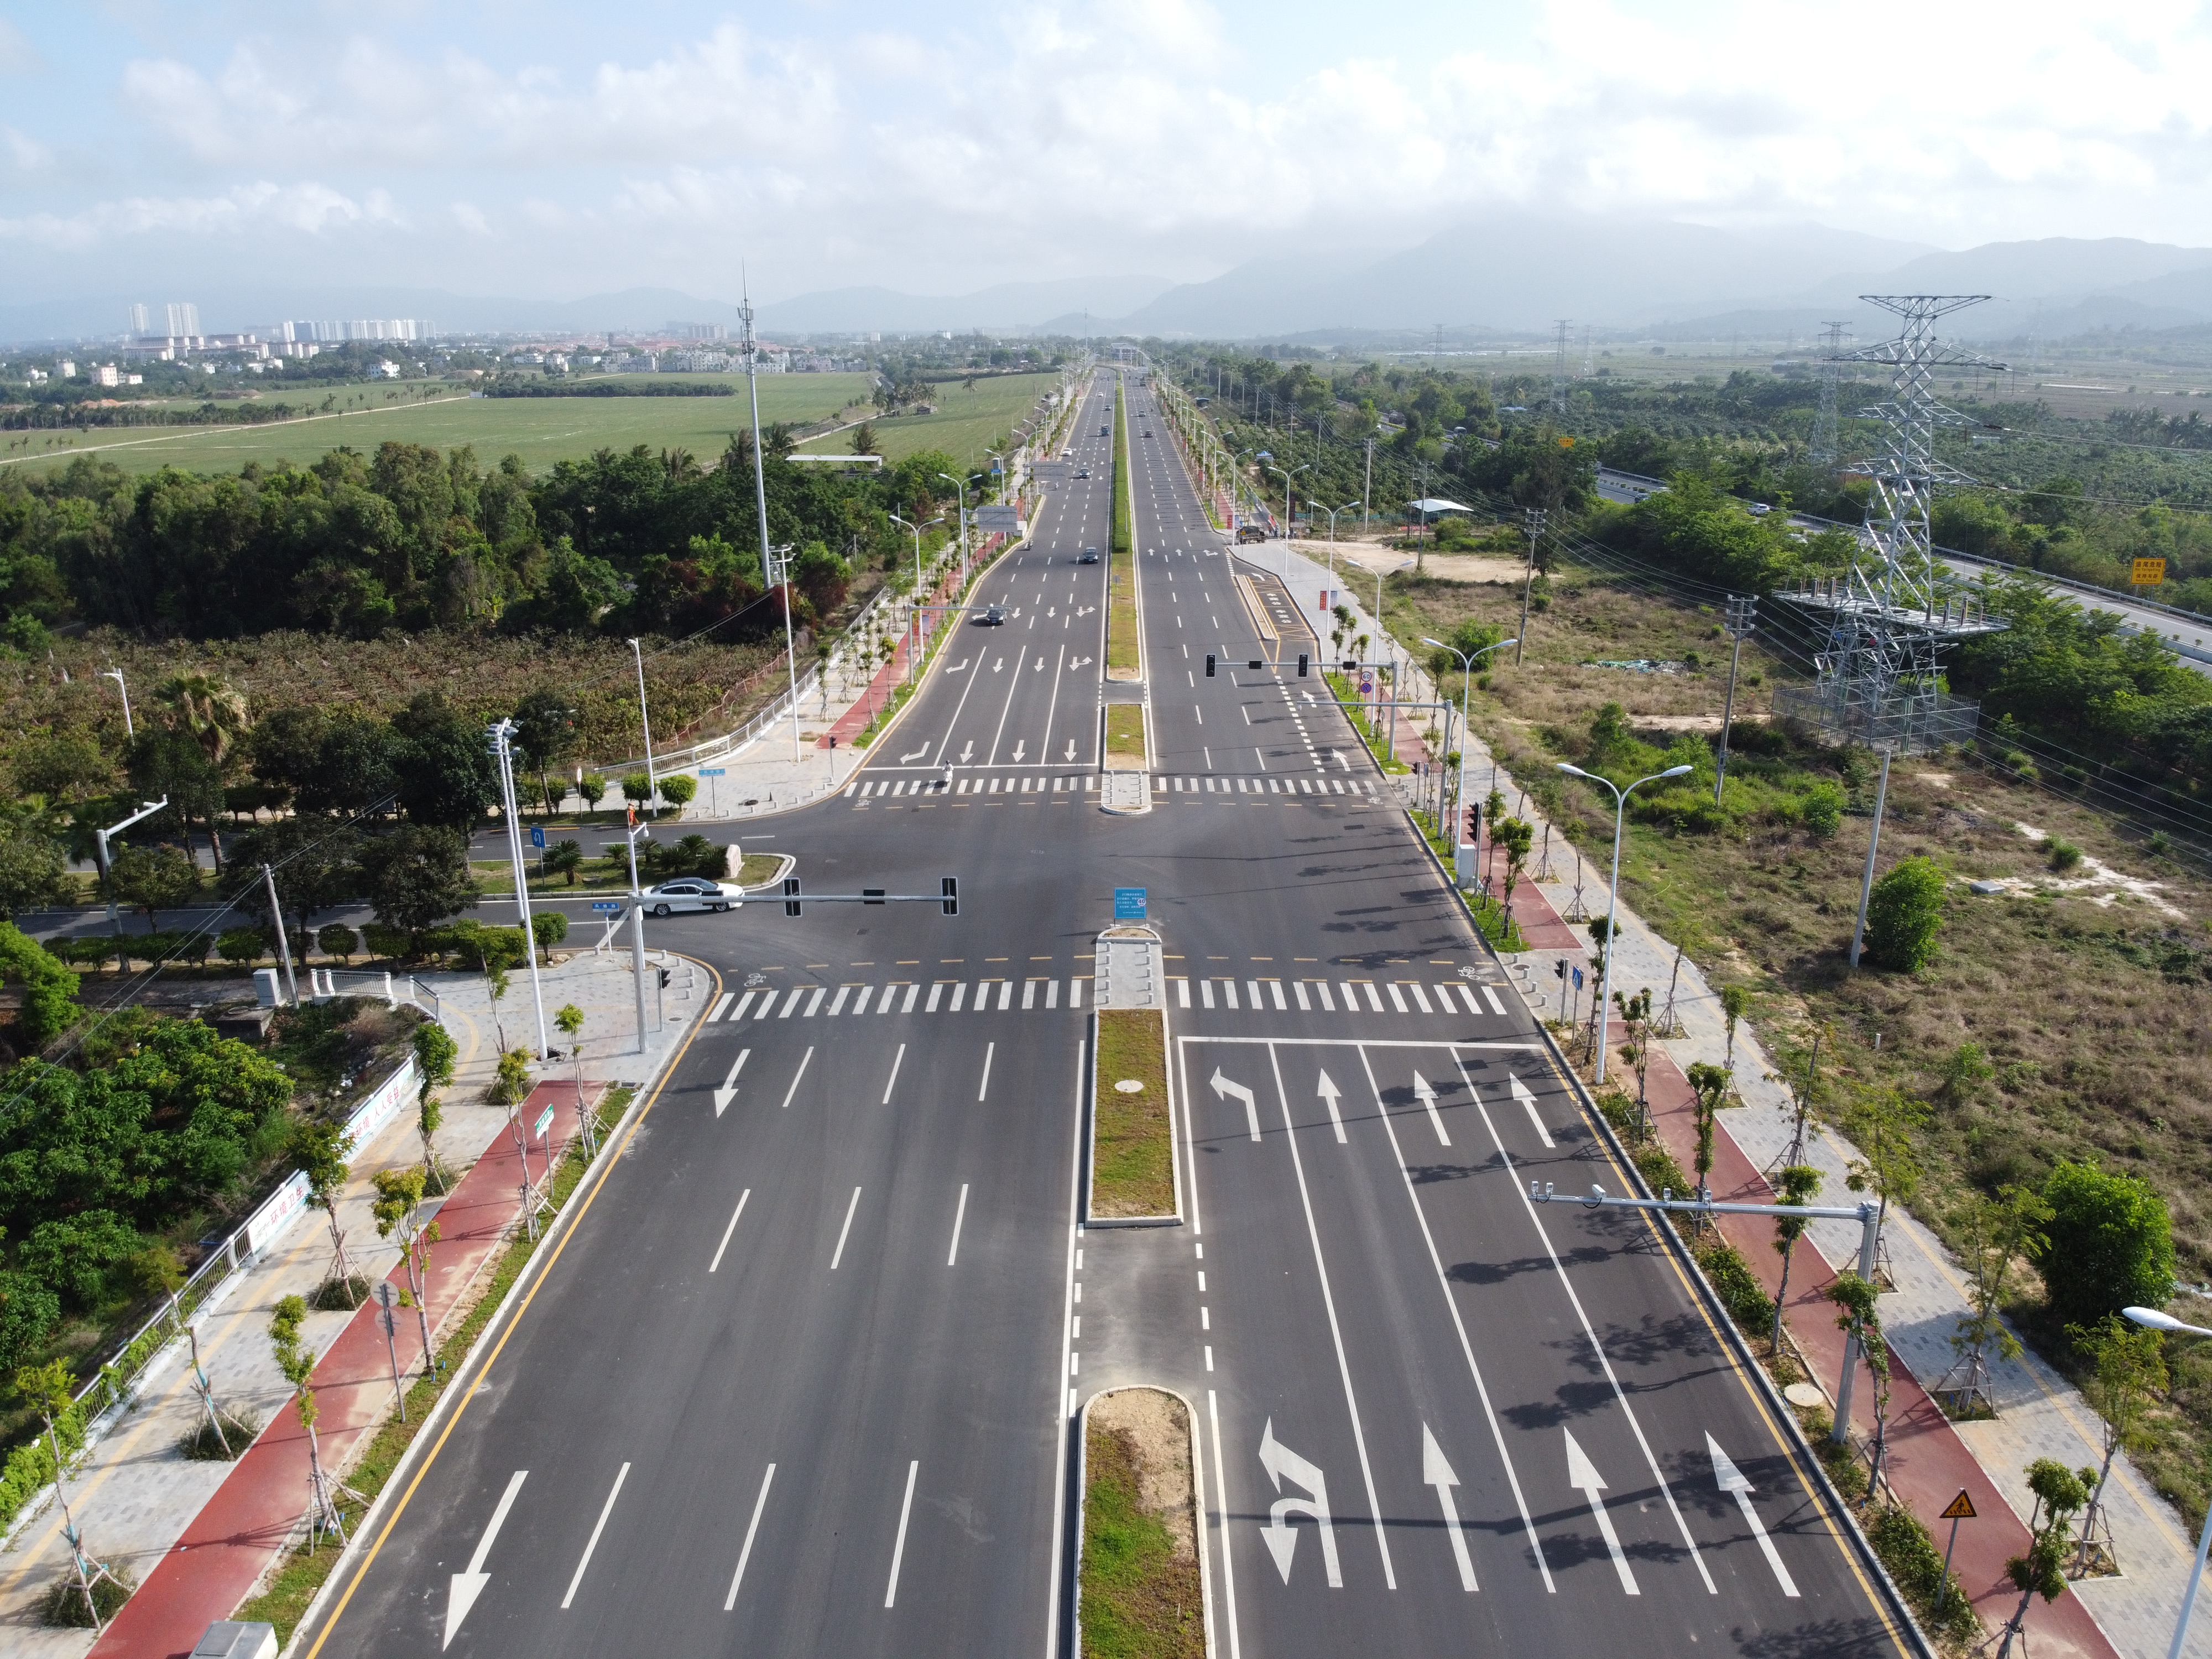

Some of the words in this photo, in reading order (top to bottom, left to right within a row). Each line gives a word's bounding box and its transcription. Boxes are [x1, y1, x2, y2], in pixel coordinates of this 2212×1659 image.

[374, 1086, 400, 1120] 人人受益
[270, 1185, 304, 1225] 环境卫生
